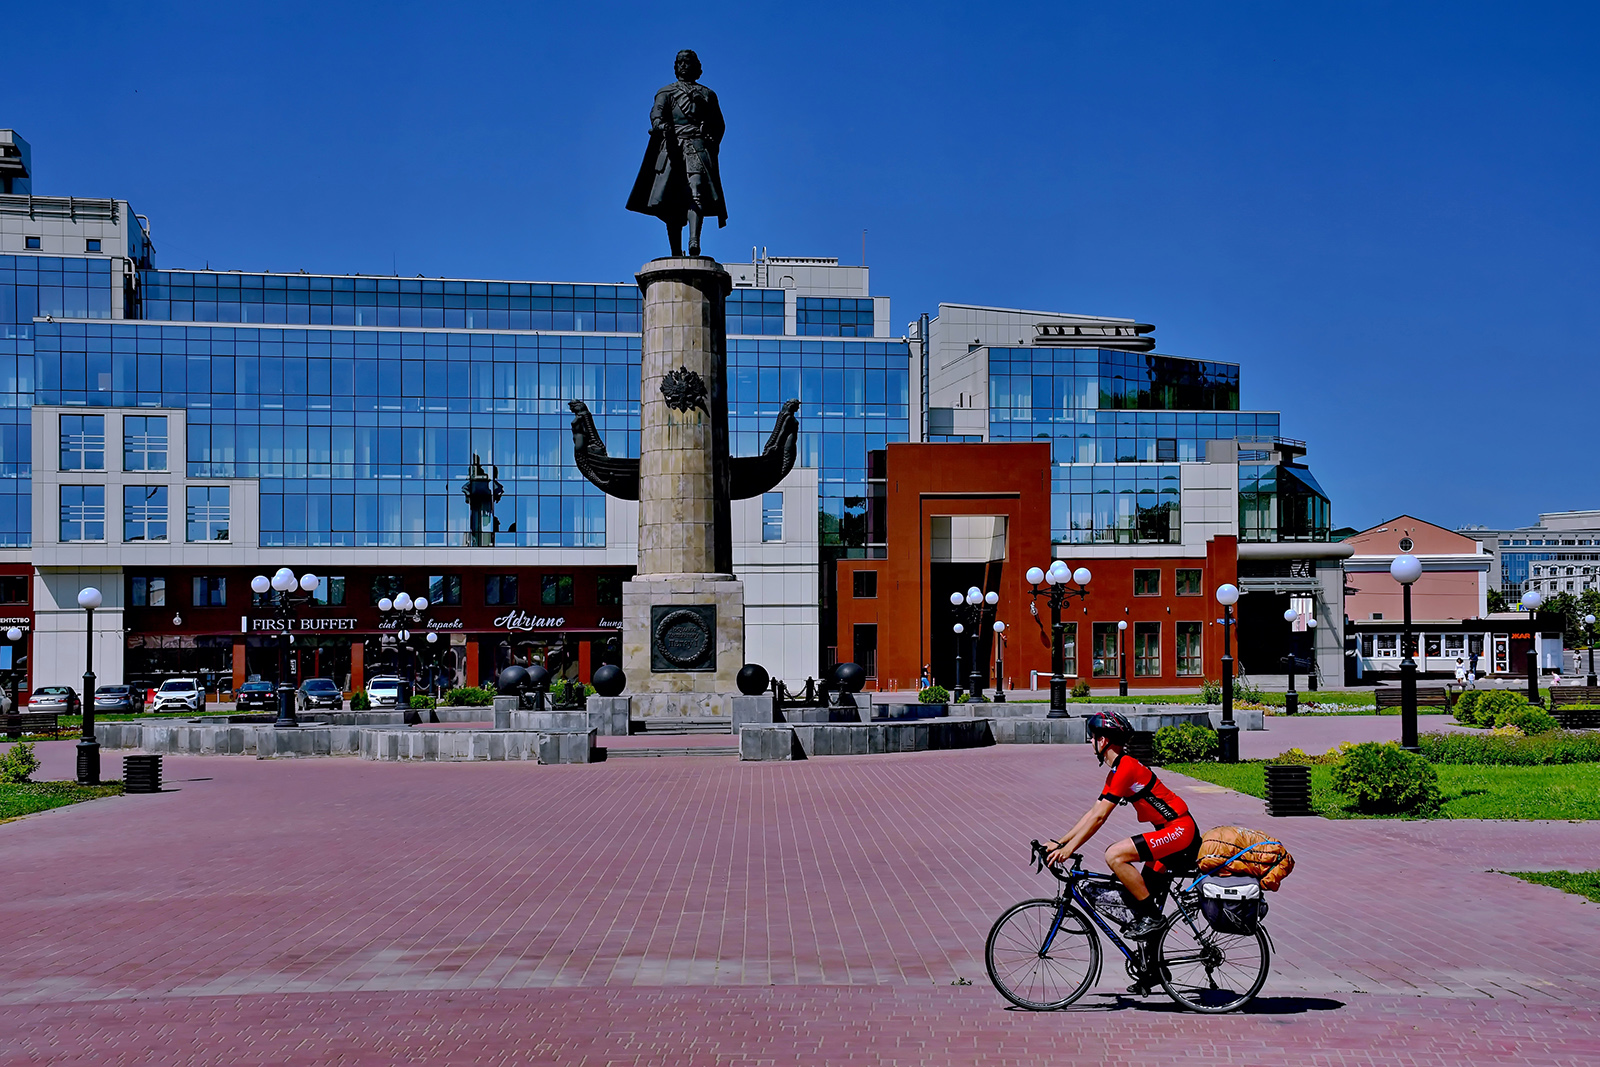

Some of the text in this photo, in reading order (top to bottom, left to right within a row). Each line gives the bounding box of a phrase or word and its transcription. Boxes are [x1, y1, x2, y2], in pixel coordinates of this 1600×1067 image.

[252, 618, 357, 631] FIRST BUFFET
[493, 609, 565, 631] Adriano
